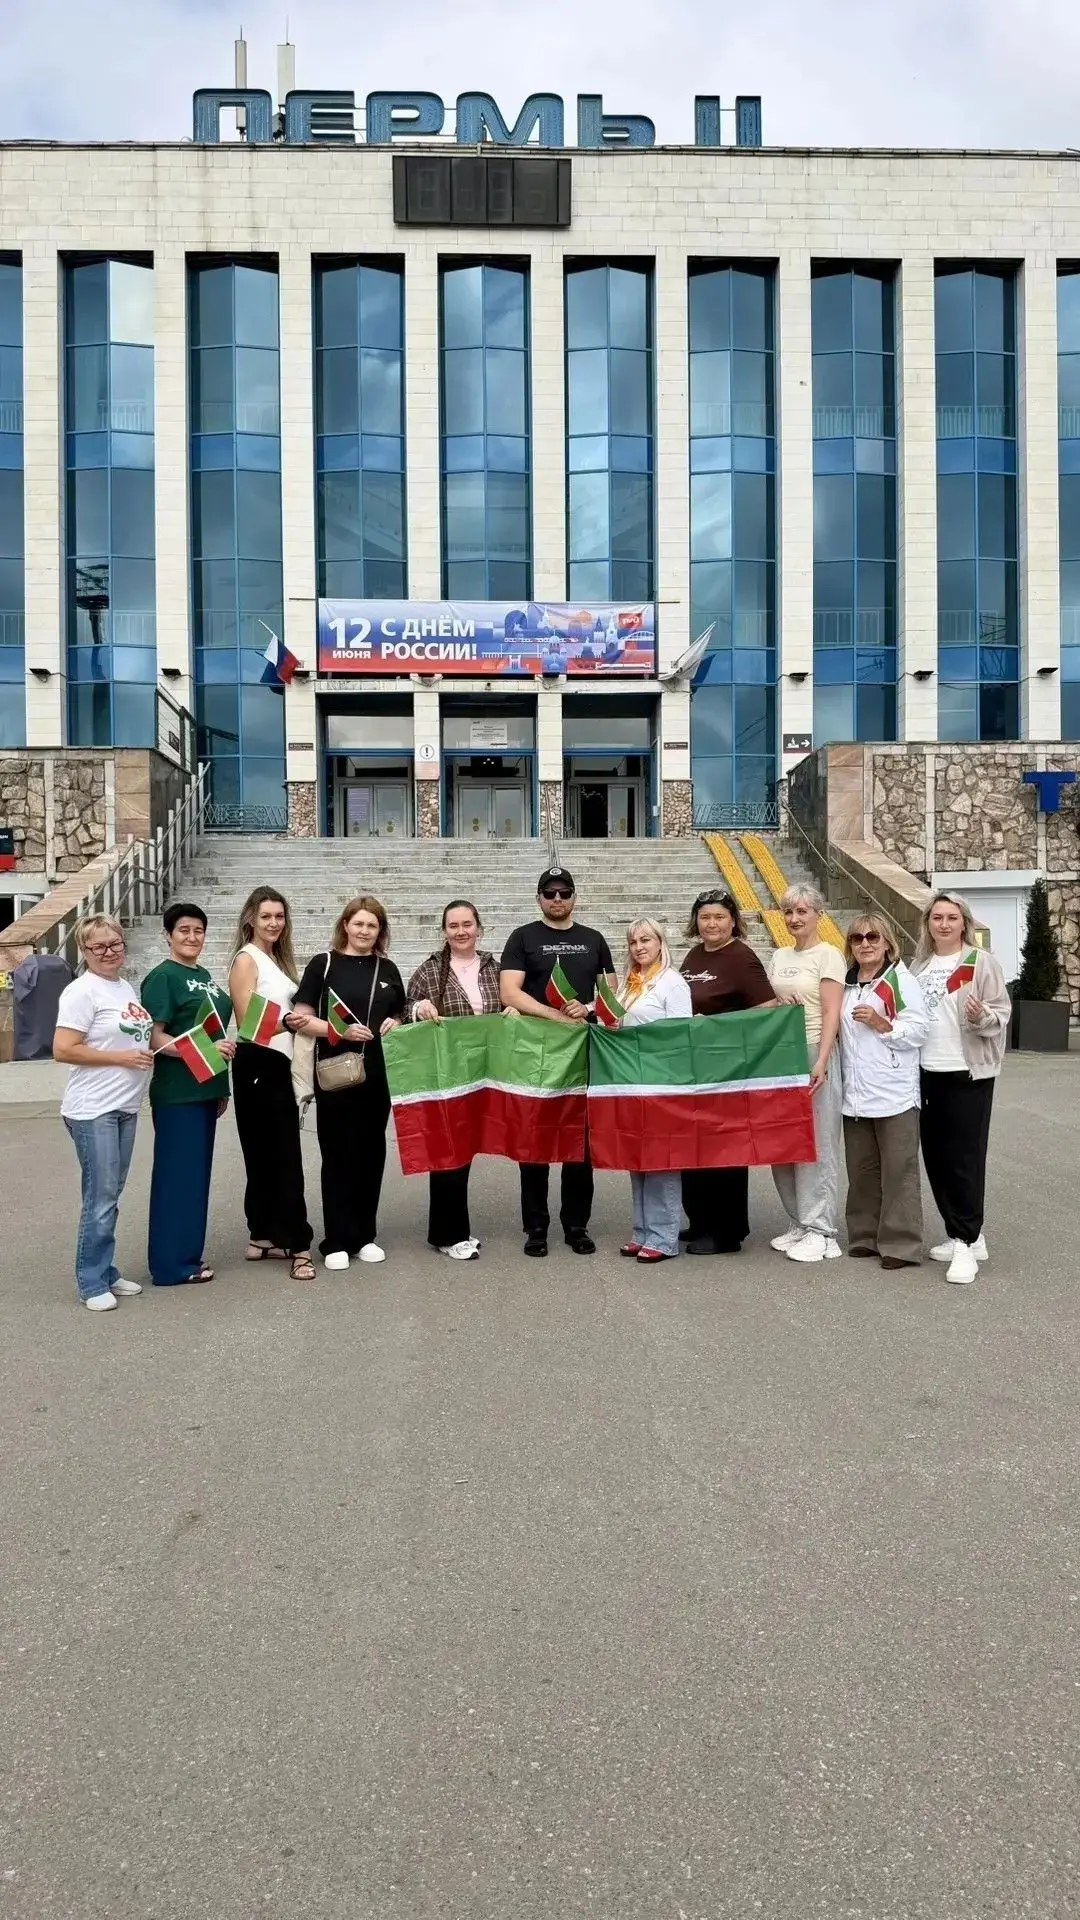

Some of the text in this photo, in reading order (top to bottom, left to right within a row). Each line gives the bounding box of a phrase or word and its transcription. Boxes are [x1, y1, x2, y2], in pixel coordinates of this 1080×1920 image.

[193, 88, 656, 147] ПЕРМЬ
[328, 618, 373, 649] 12
[381, 615, 475, 640] С ДНЁМ
[381, 642, 477, 660] РОССИИ!
